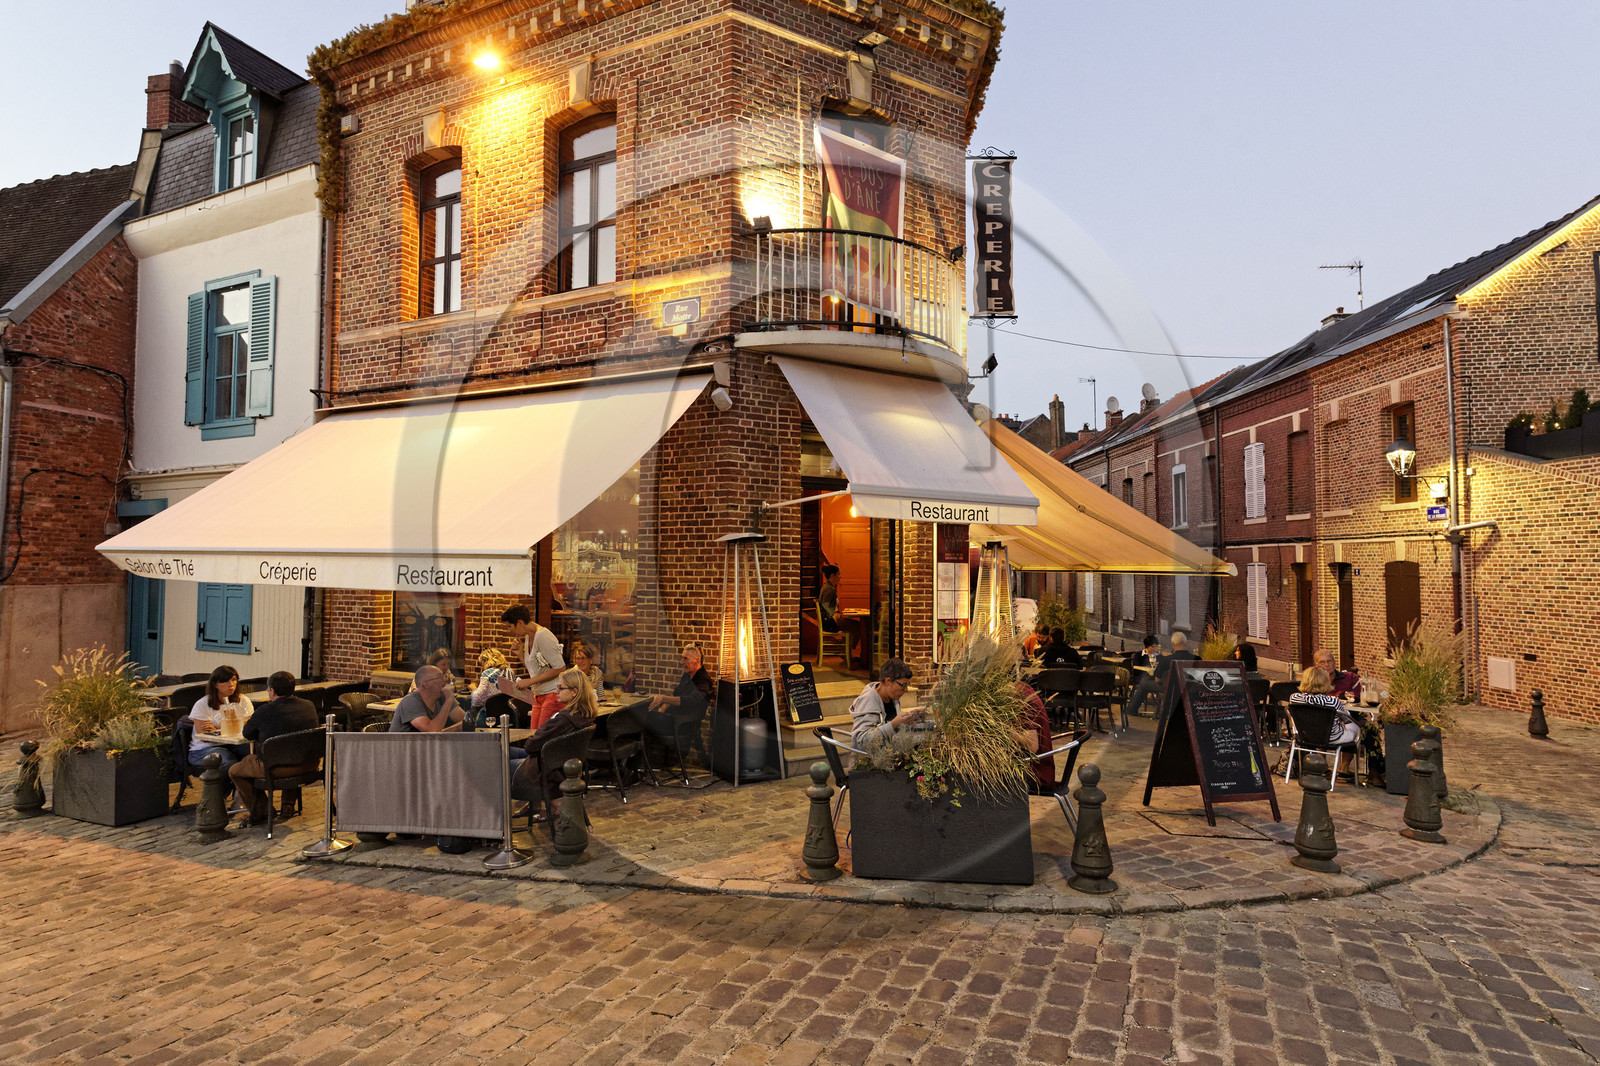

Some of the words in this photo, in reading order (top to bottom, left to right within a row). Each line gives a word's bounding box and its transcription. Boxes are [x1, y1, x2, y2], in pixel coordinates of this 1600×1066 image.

[840, 151, 854, 179] LE
[859, 160, 884, 190] DOS
[843, 177, 882, 214] D'ÂNE
[981, 164, 1006, 310] CREPERIE
[672, 313, 692, 322] Motte
[675, 304, 689, 313] Rue
[911, 500, 989, 522] Restaurant
[124, 557, 157, 575] Salon
[158, 558, 172, 575] de
[173, 558, 195, 577] Thé
[259, 560, 317, 584] Créperie
[396, 564, 494, 587] Restaurant
